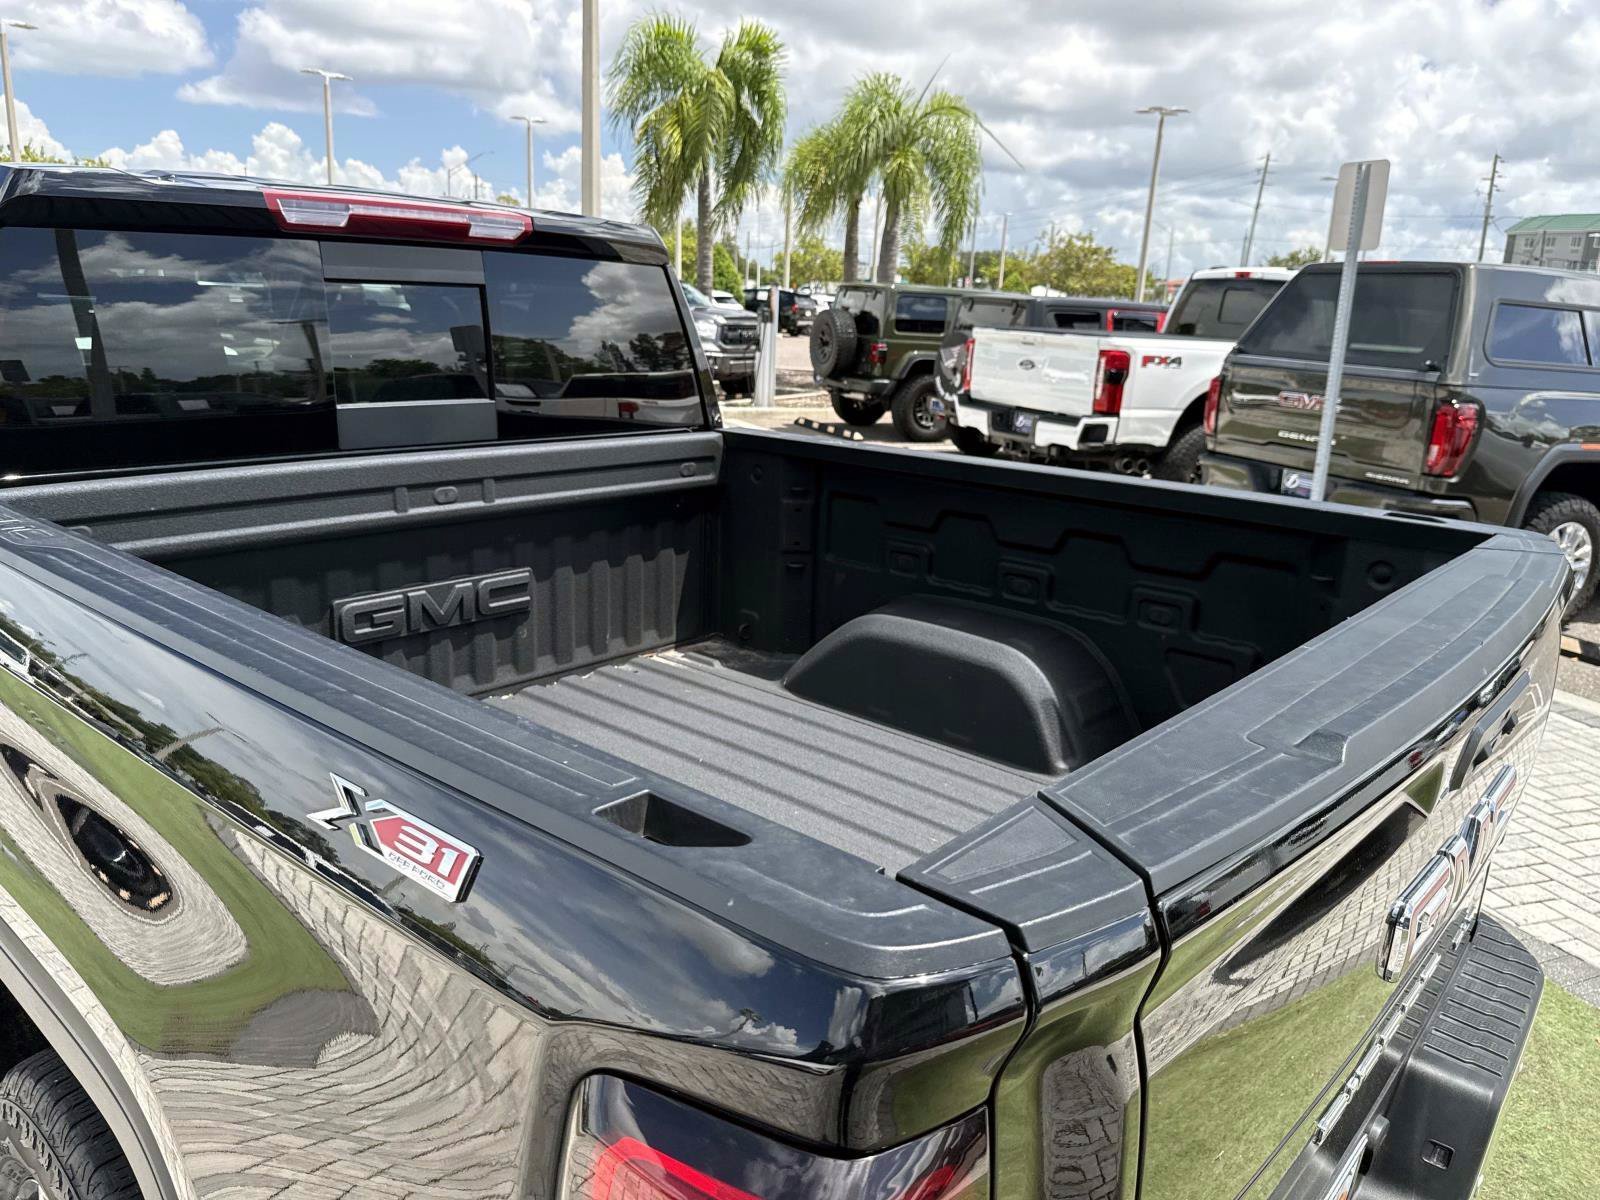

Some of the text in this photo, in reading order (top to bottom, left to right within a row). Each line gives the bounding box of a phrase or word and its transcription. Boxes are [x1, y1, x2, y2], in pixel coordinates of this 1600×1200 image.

[1142, 355, 1182, 368] FX4
[1279, 391, 1341, 413] GM
[340, 572, 531, 642] GMC
